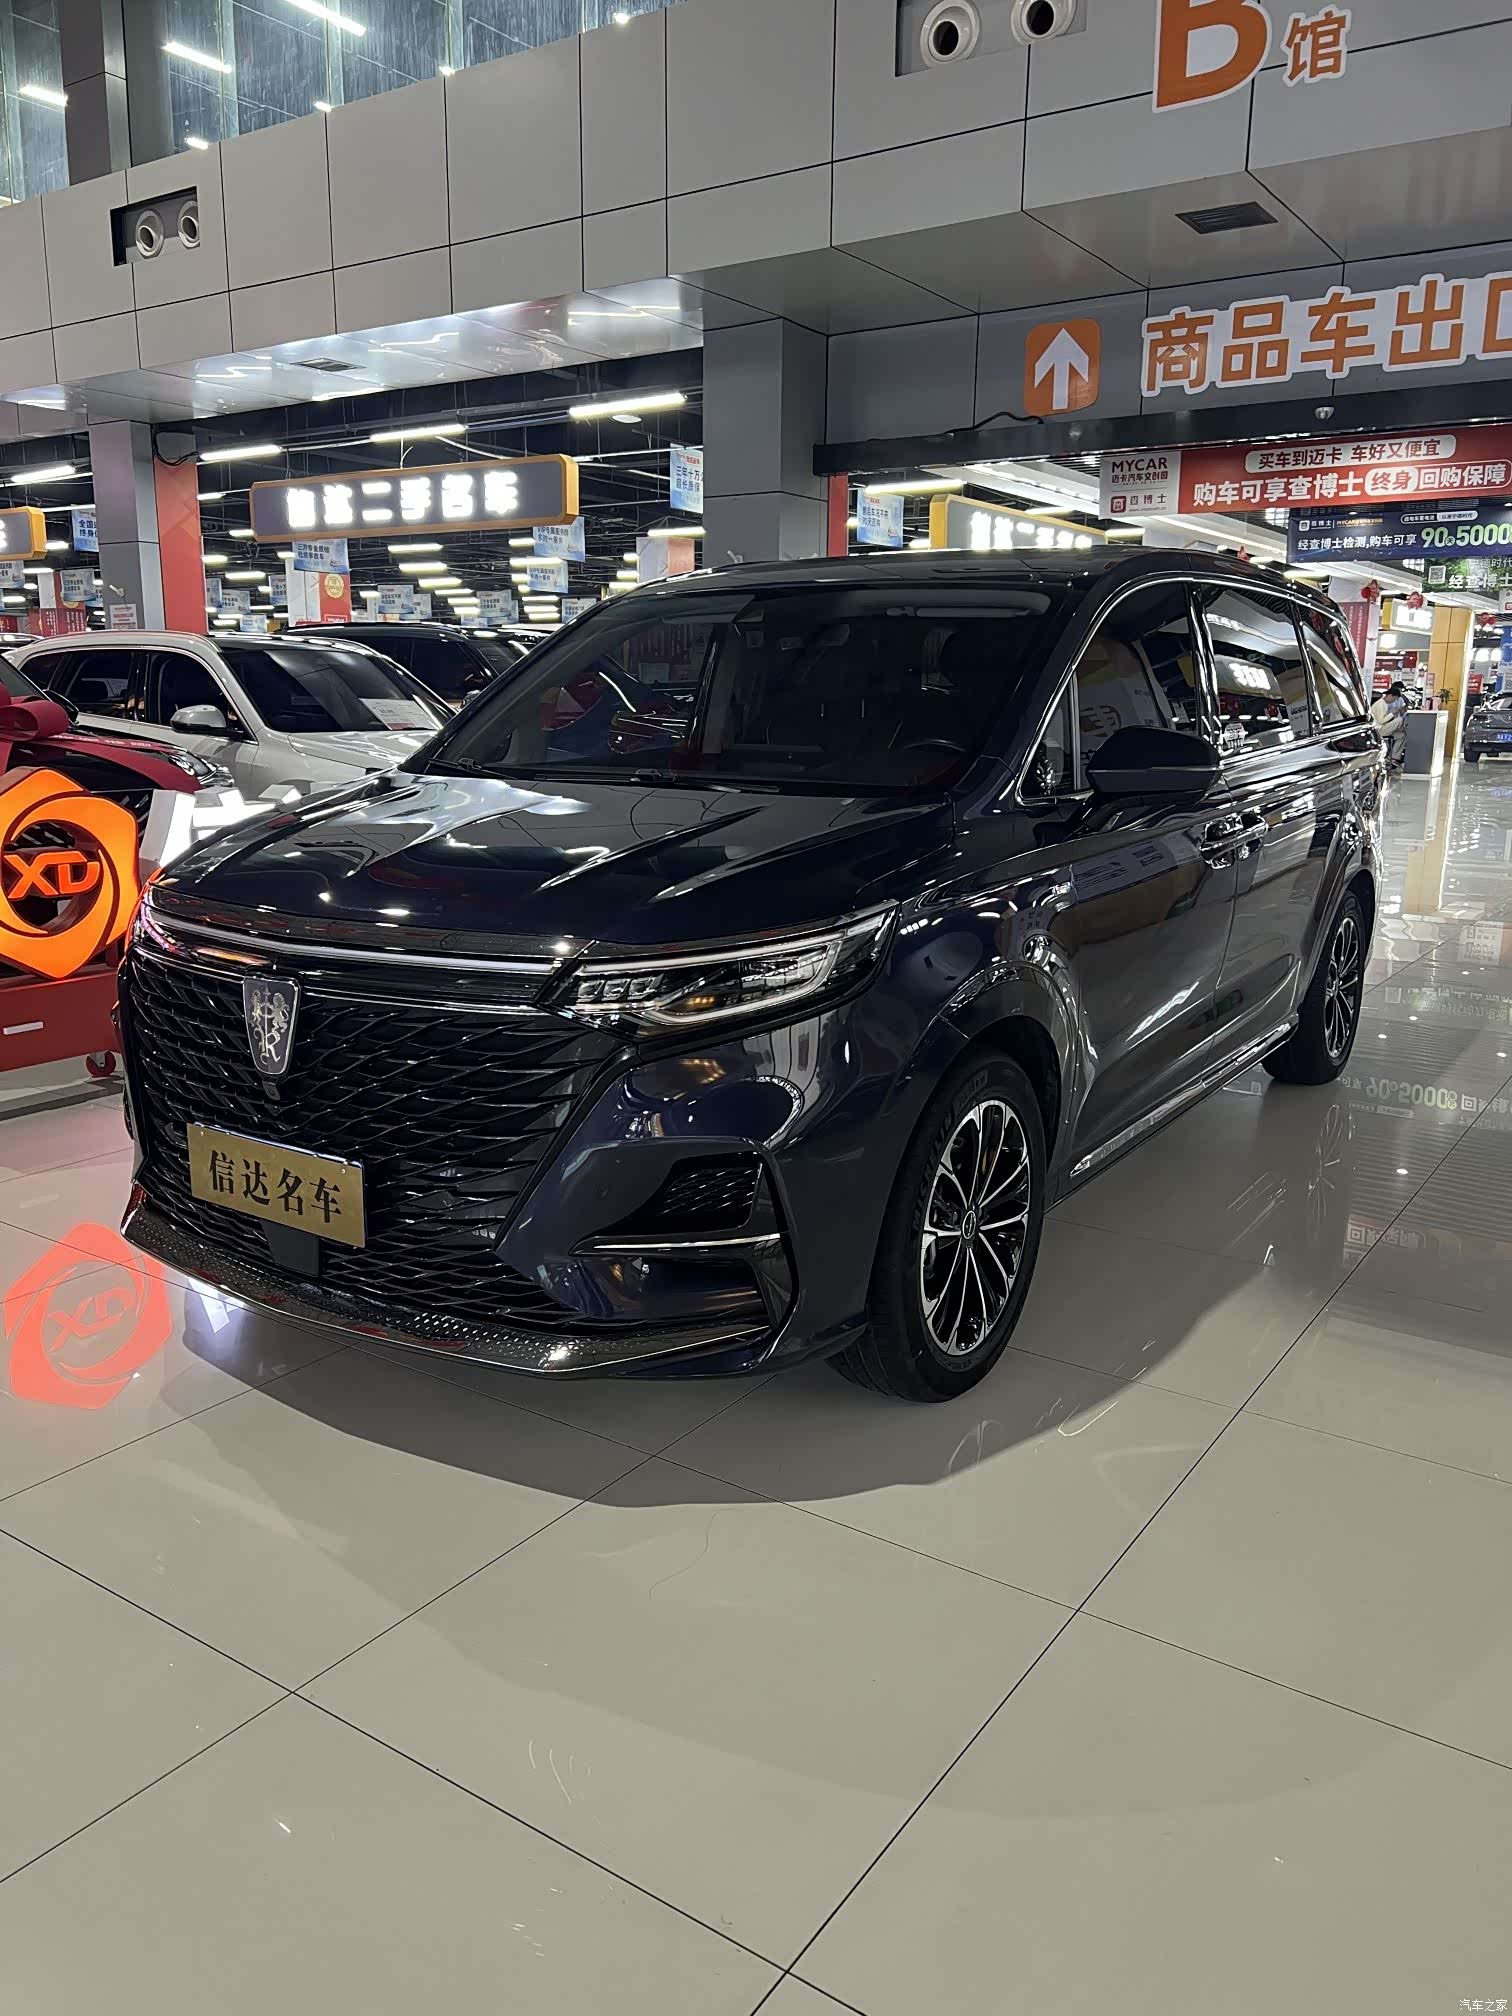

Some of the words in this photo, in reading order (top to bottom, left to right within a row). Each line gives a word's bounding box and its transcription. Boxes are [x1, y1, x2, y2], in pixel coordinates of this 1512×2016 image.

[1112, 457, 1168, 473] MYCAR
[1259, 447, 1343, 470] 买车到迈卡
[1351, 438, 1441, 462] 车好又便宜
[208, 1149, 342, 1224] 信达名车
